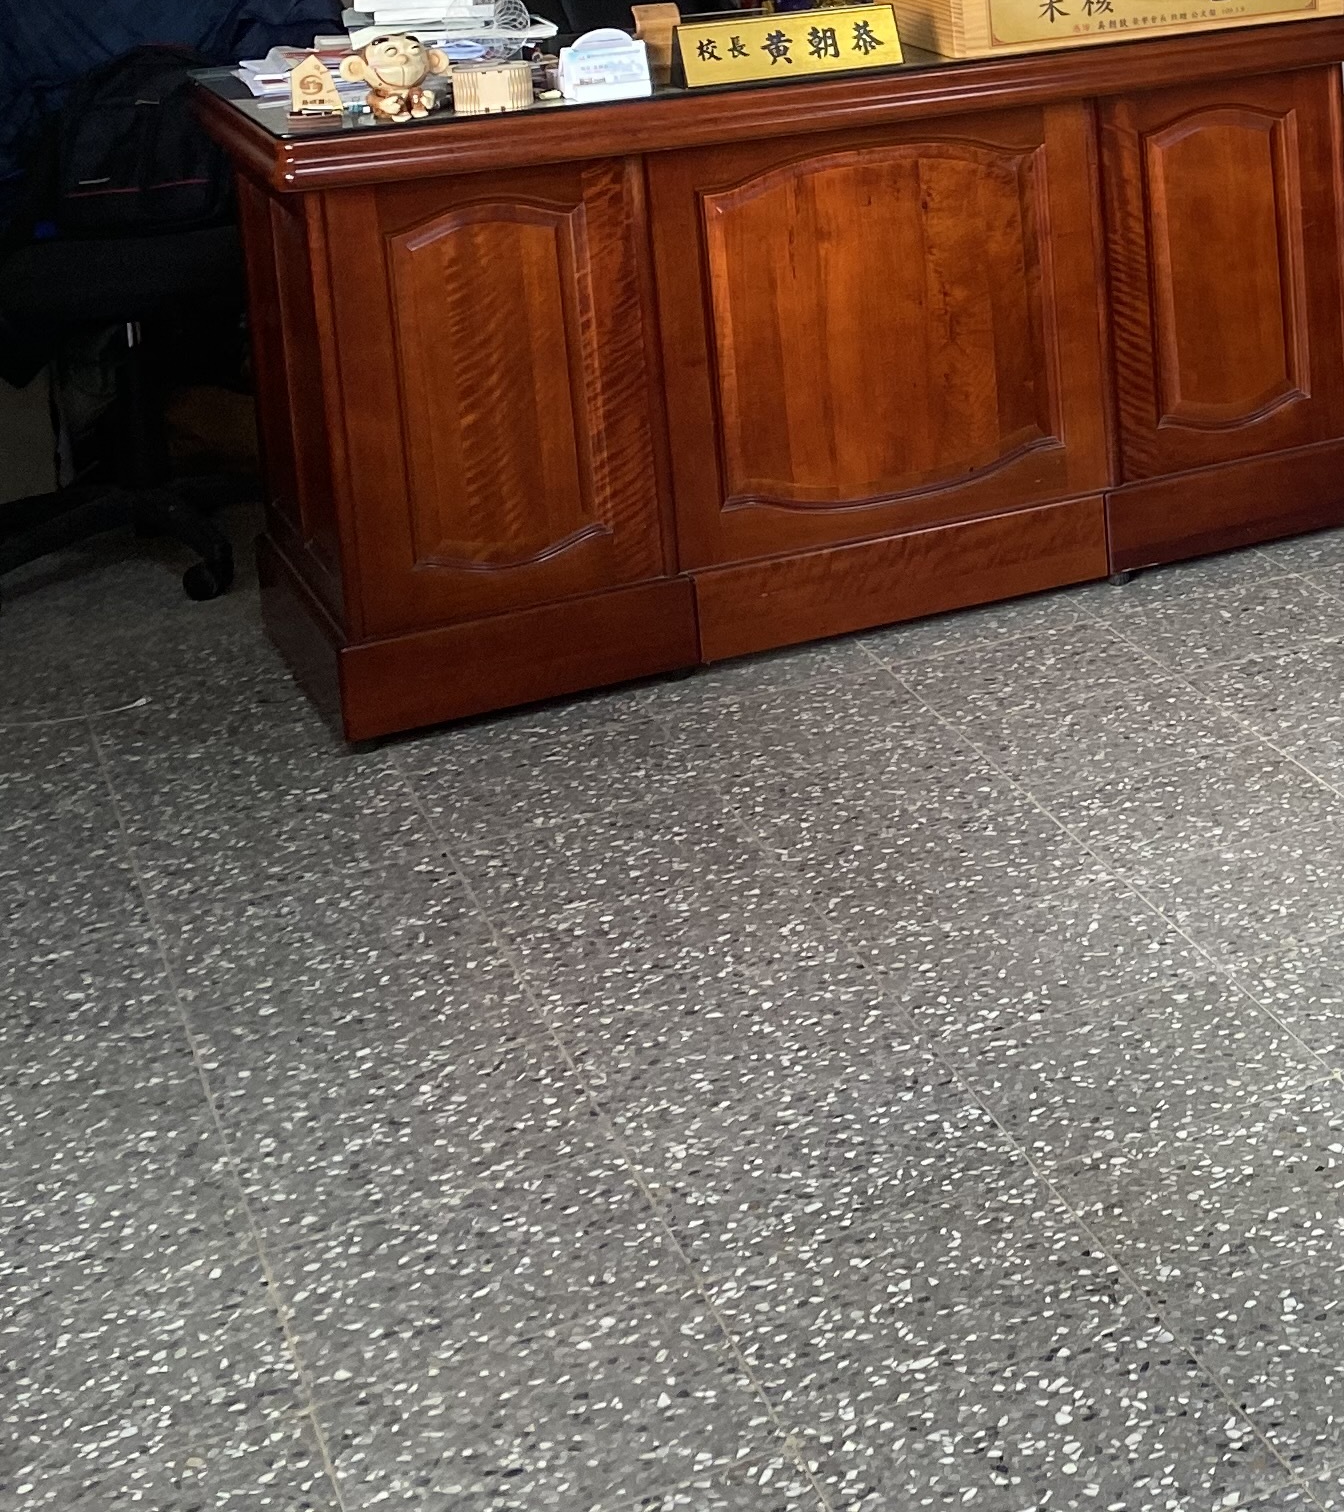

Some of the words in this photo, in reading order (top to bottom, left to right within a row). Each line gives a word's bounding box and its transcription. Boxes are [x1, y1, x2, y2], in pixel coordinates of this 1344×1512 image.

[697, 37, 750, 64] 校長
[761, 20, 885, 67] 黃朝恭
